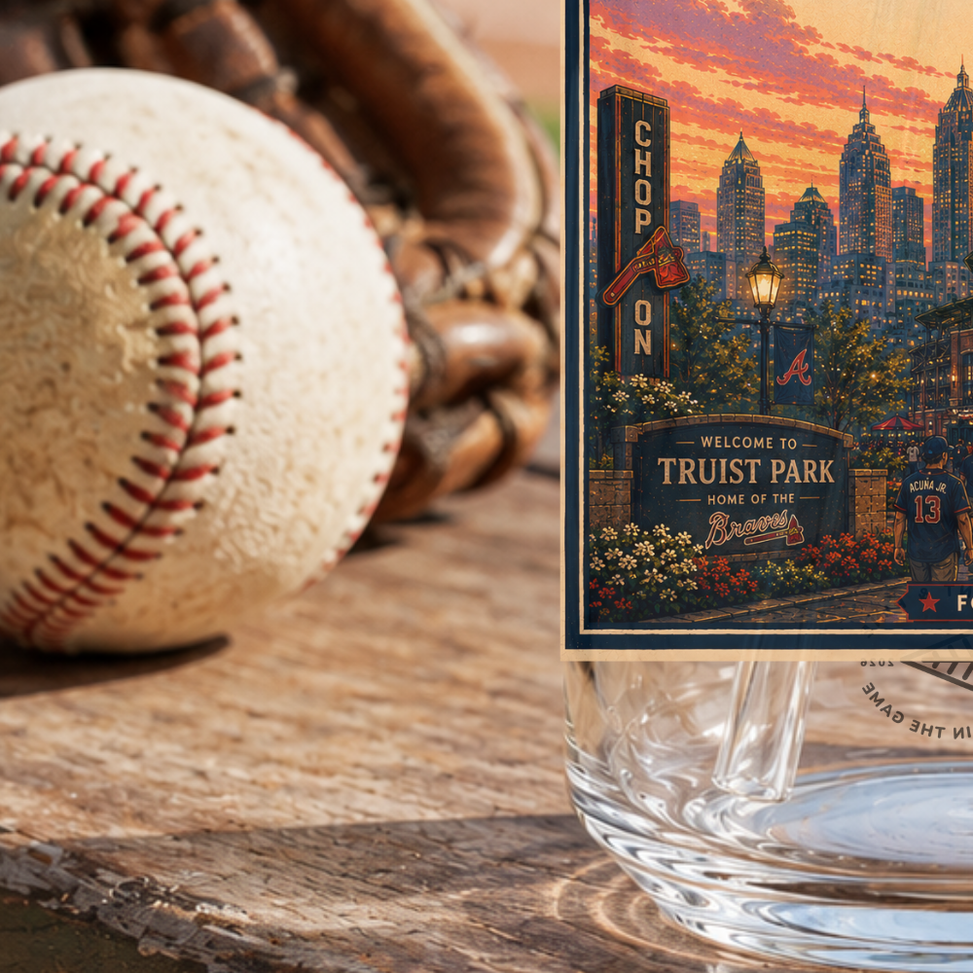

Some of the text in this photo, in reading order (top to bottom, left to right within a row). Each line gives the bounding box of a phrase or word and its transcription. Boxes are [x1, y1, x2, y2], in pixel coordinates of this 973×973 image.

[634, 119, 652, 235] CHOP
[633, 299, 652, 357] ON
[700, 435, 798, 450] WELCOME TO
[657, 457, 836, 485] TRUIST PARK
[707, 492, 796, 505] HOME OF THE
[914, 494, 941, 524] 13
[704, 508, 789, 550] Braves
